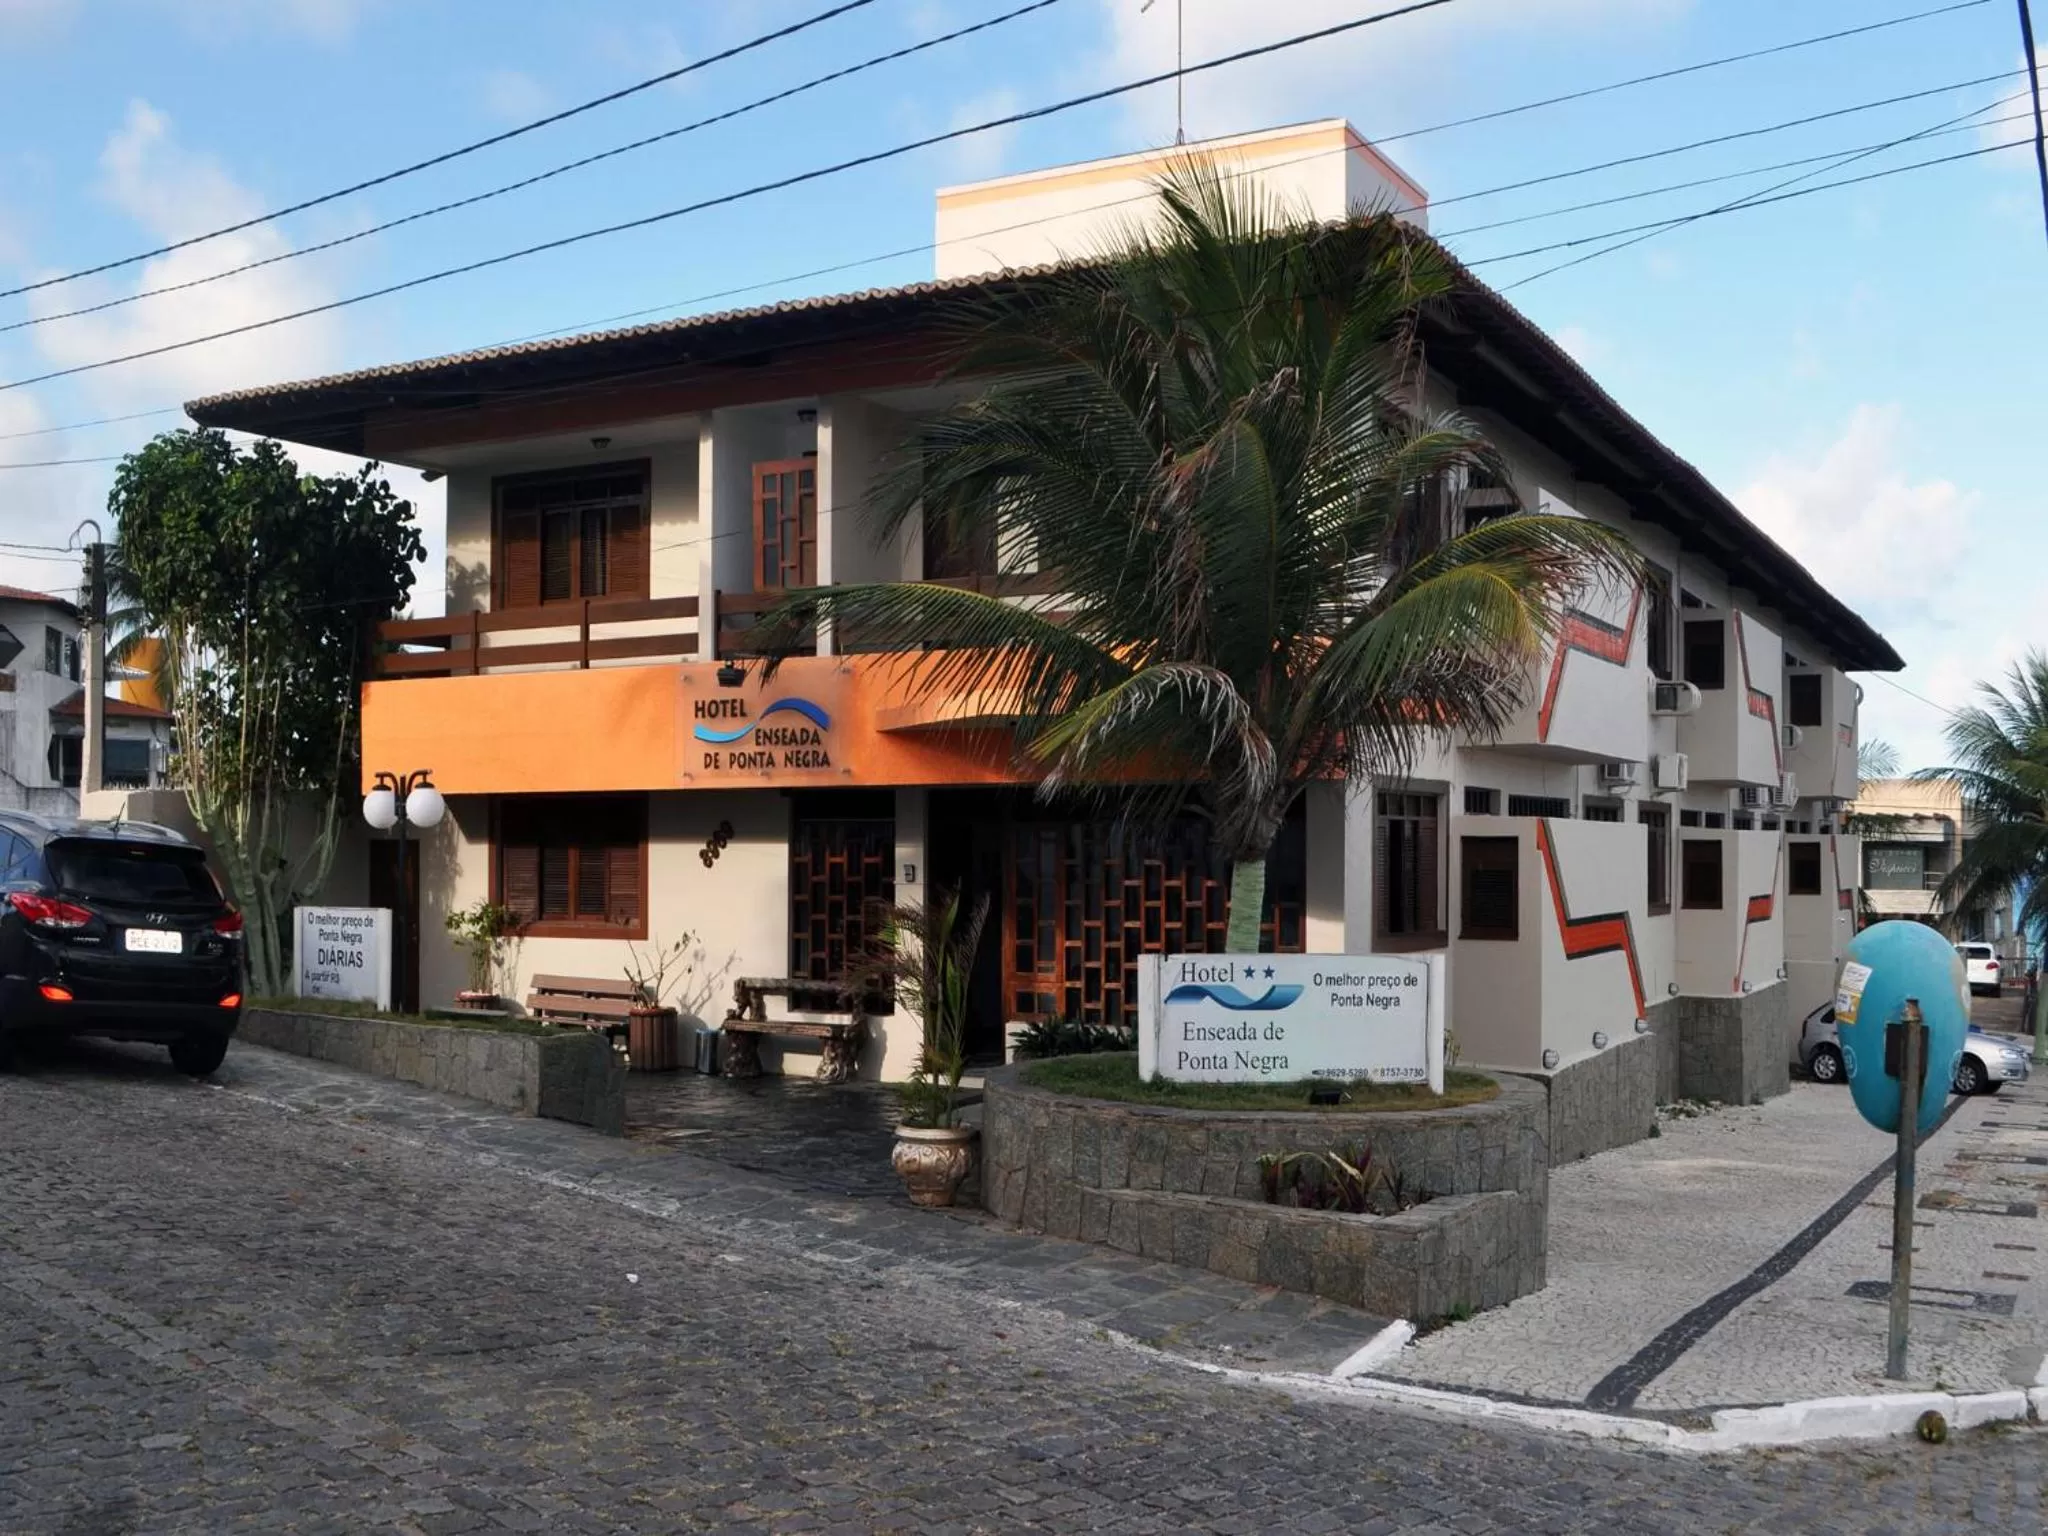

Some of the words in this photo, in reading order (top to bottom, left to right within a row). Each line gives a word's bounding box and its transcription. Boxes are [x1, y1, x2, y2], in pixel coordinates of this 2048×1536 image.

[694, 699, 748, 719] HOTEL
[754, 727, 822, 747] ENSEADA
[704, 752, 720, 769] DE
[729, 752, 776, 769] PONTA
[784, 751, 831, 768] NEGRA
[308, 911, 315, 925] O
[315, 914, 340, 926] melhor
[341, 916, 363, 929] preço
[364, 915, 374, 928] de
[319, 928, 340, 942] Ponta
[341, 928, 363, 946] Negra
[317, 945, 364, 969] DIÁRIAS
[1180, 961, 1234, 983] Hotel
[1313, 972, 1323, 987] O
[1325, 974, 1366, 988] melhor
[1367, 975, 1402, 990] preço
[1403, 973, 1418, 988] de
[1330, 992, 1363, 1008] Ponta
[1365, 992, 1401, 1011] Negra
[1183, 1021, 1257, 1041] Enseada
[1263, 1021, 1285, 1041] de
[1178, 1051, 1229, 1071] Ponta
[1234, 1051, 1289, 1075] Negra
